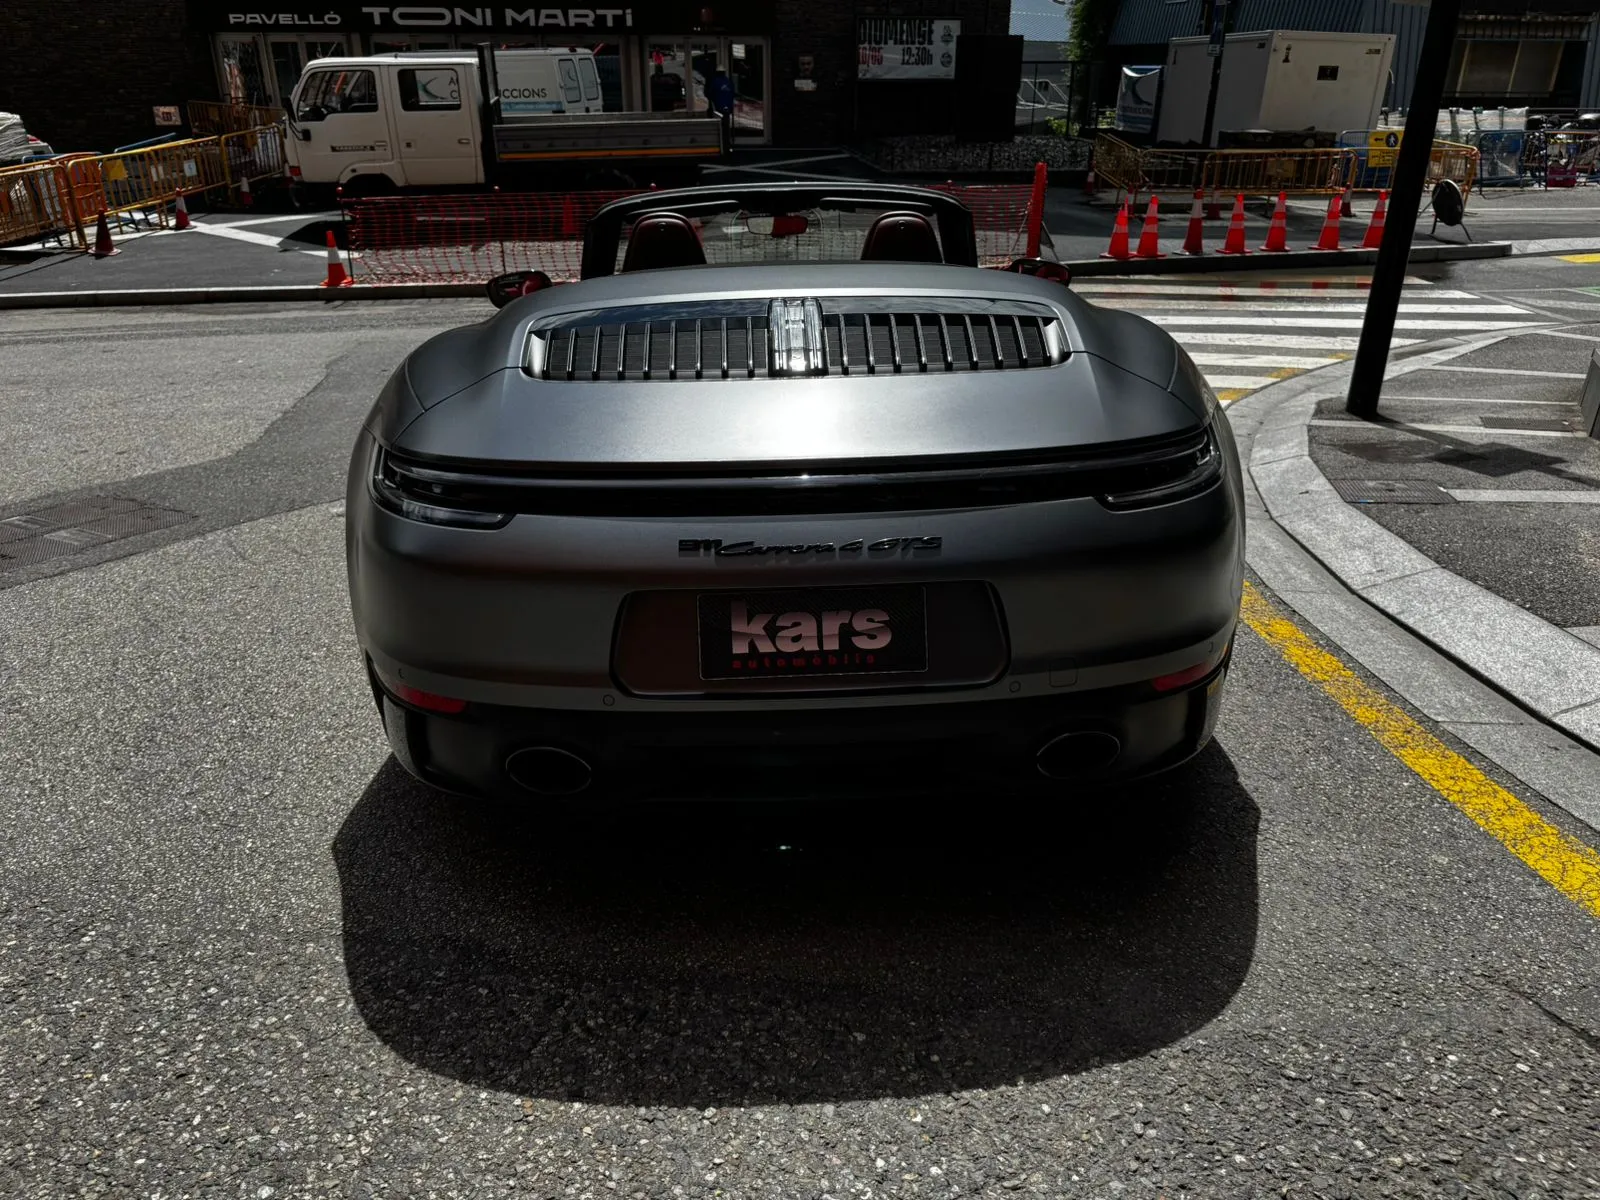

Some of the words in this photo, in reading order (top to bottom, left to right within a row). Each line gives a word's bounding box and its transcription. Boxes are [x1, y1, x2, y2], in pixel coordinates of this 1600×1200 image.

[362, 7, 492, 26] TONI
[859, 19, 934, 45] DIUMENGE
[901, 46, 933, 66] 12:30h
[715, 541, 836, 556] Carrera
[867, 536, 942, 551] GTS
[731, 600, 892, 654] kars
